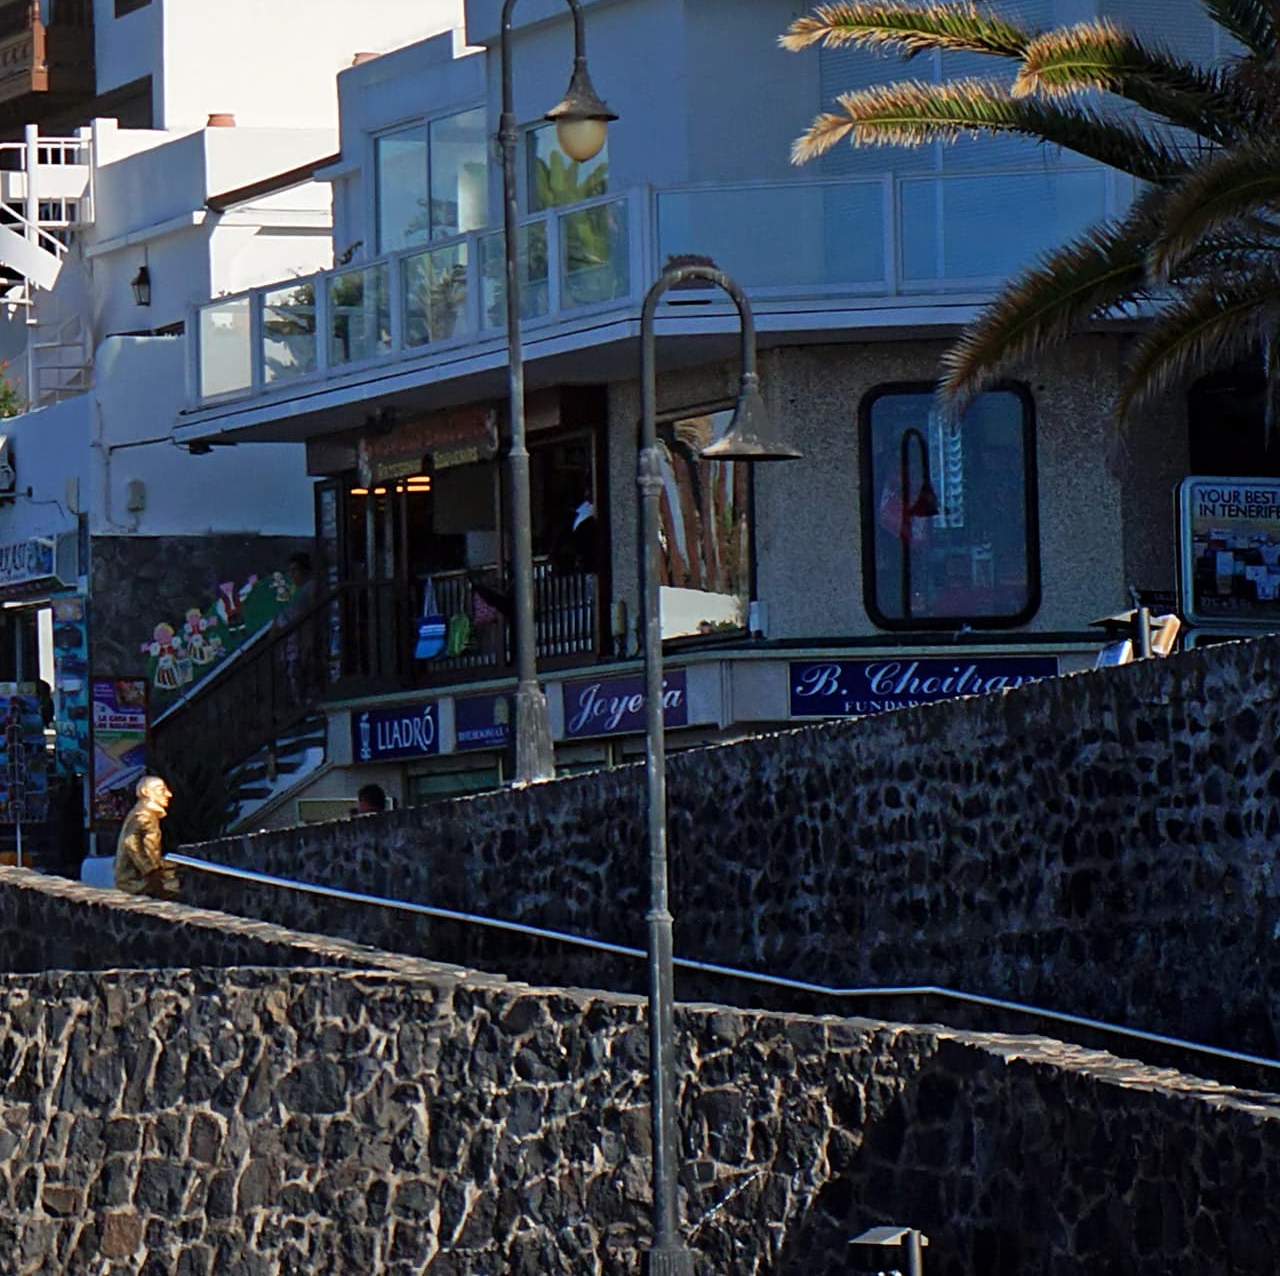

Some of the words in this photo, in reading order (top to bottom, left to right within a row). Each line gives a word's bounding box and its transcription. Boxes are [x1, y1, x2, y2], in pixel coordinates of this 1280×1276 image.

[1198, 488, 1241, 505] YOUR
[1245, 490, 1278, 505] BEST
[1199, 504, 1217, 517] IN
[568, 680, 683, 733] Joyea
[376, 705, 435, 752] LLADRÓ
